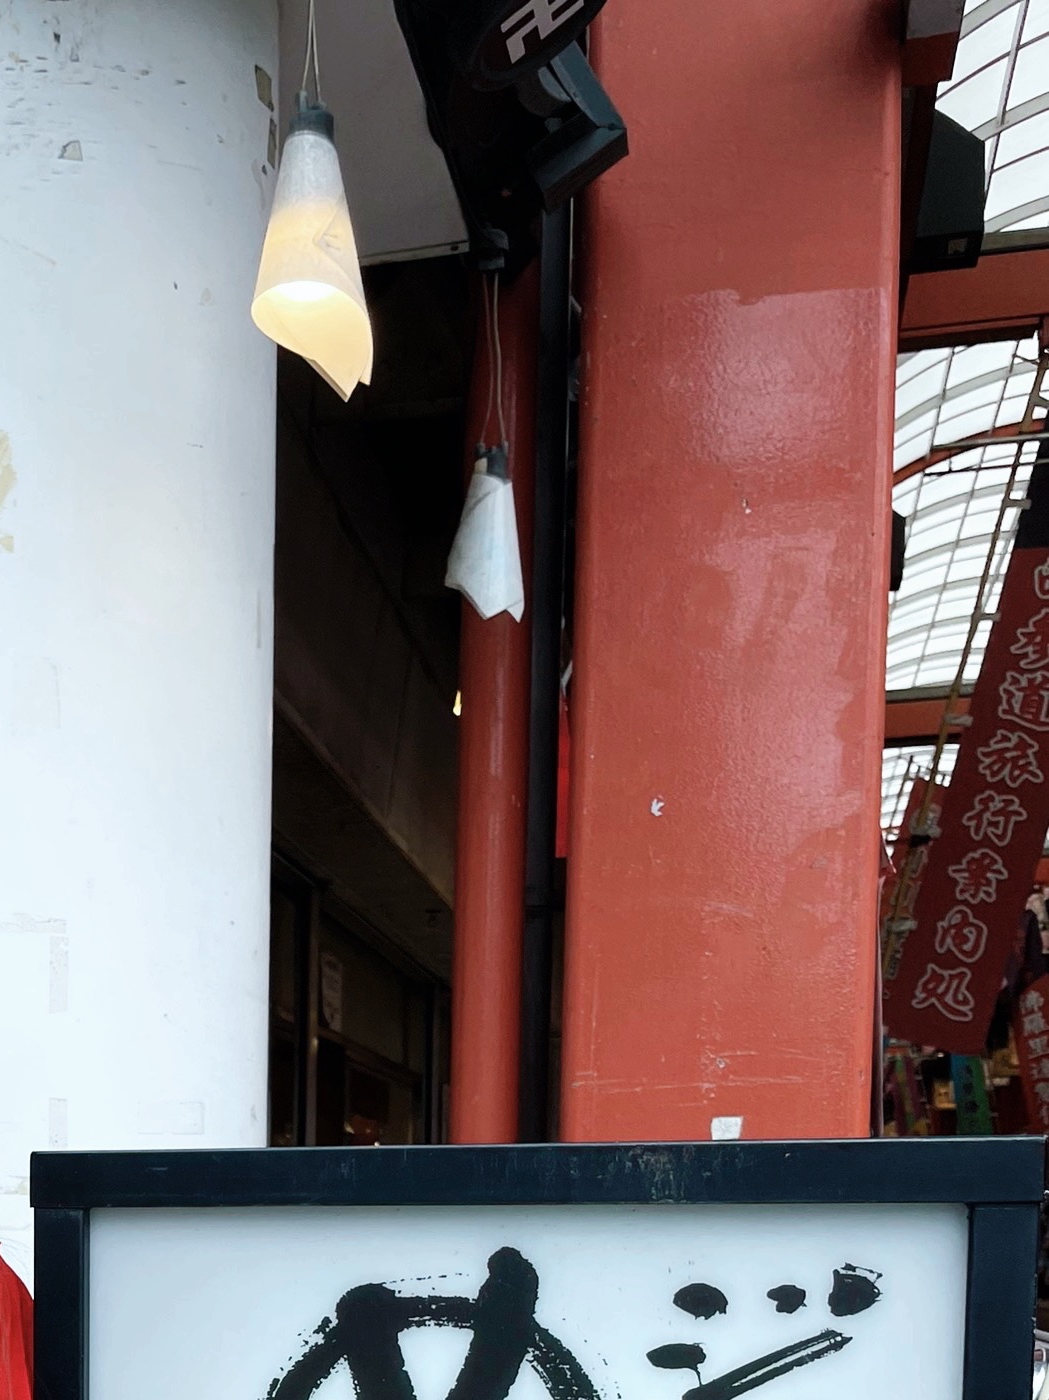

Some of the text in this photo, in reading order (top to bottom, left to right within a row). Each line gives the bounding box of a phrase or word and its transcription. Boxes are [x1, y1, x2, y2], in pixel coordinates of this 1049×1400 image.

[912, 556, 1049, 1021] 参道旅行案内処
